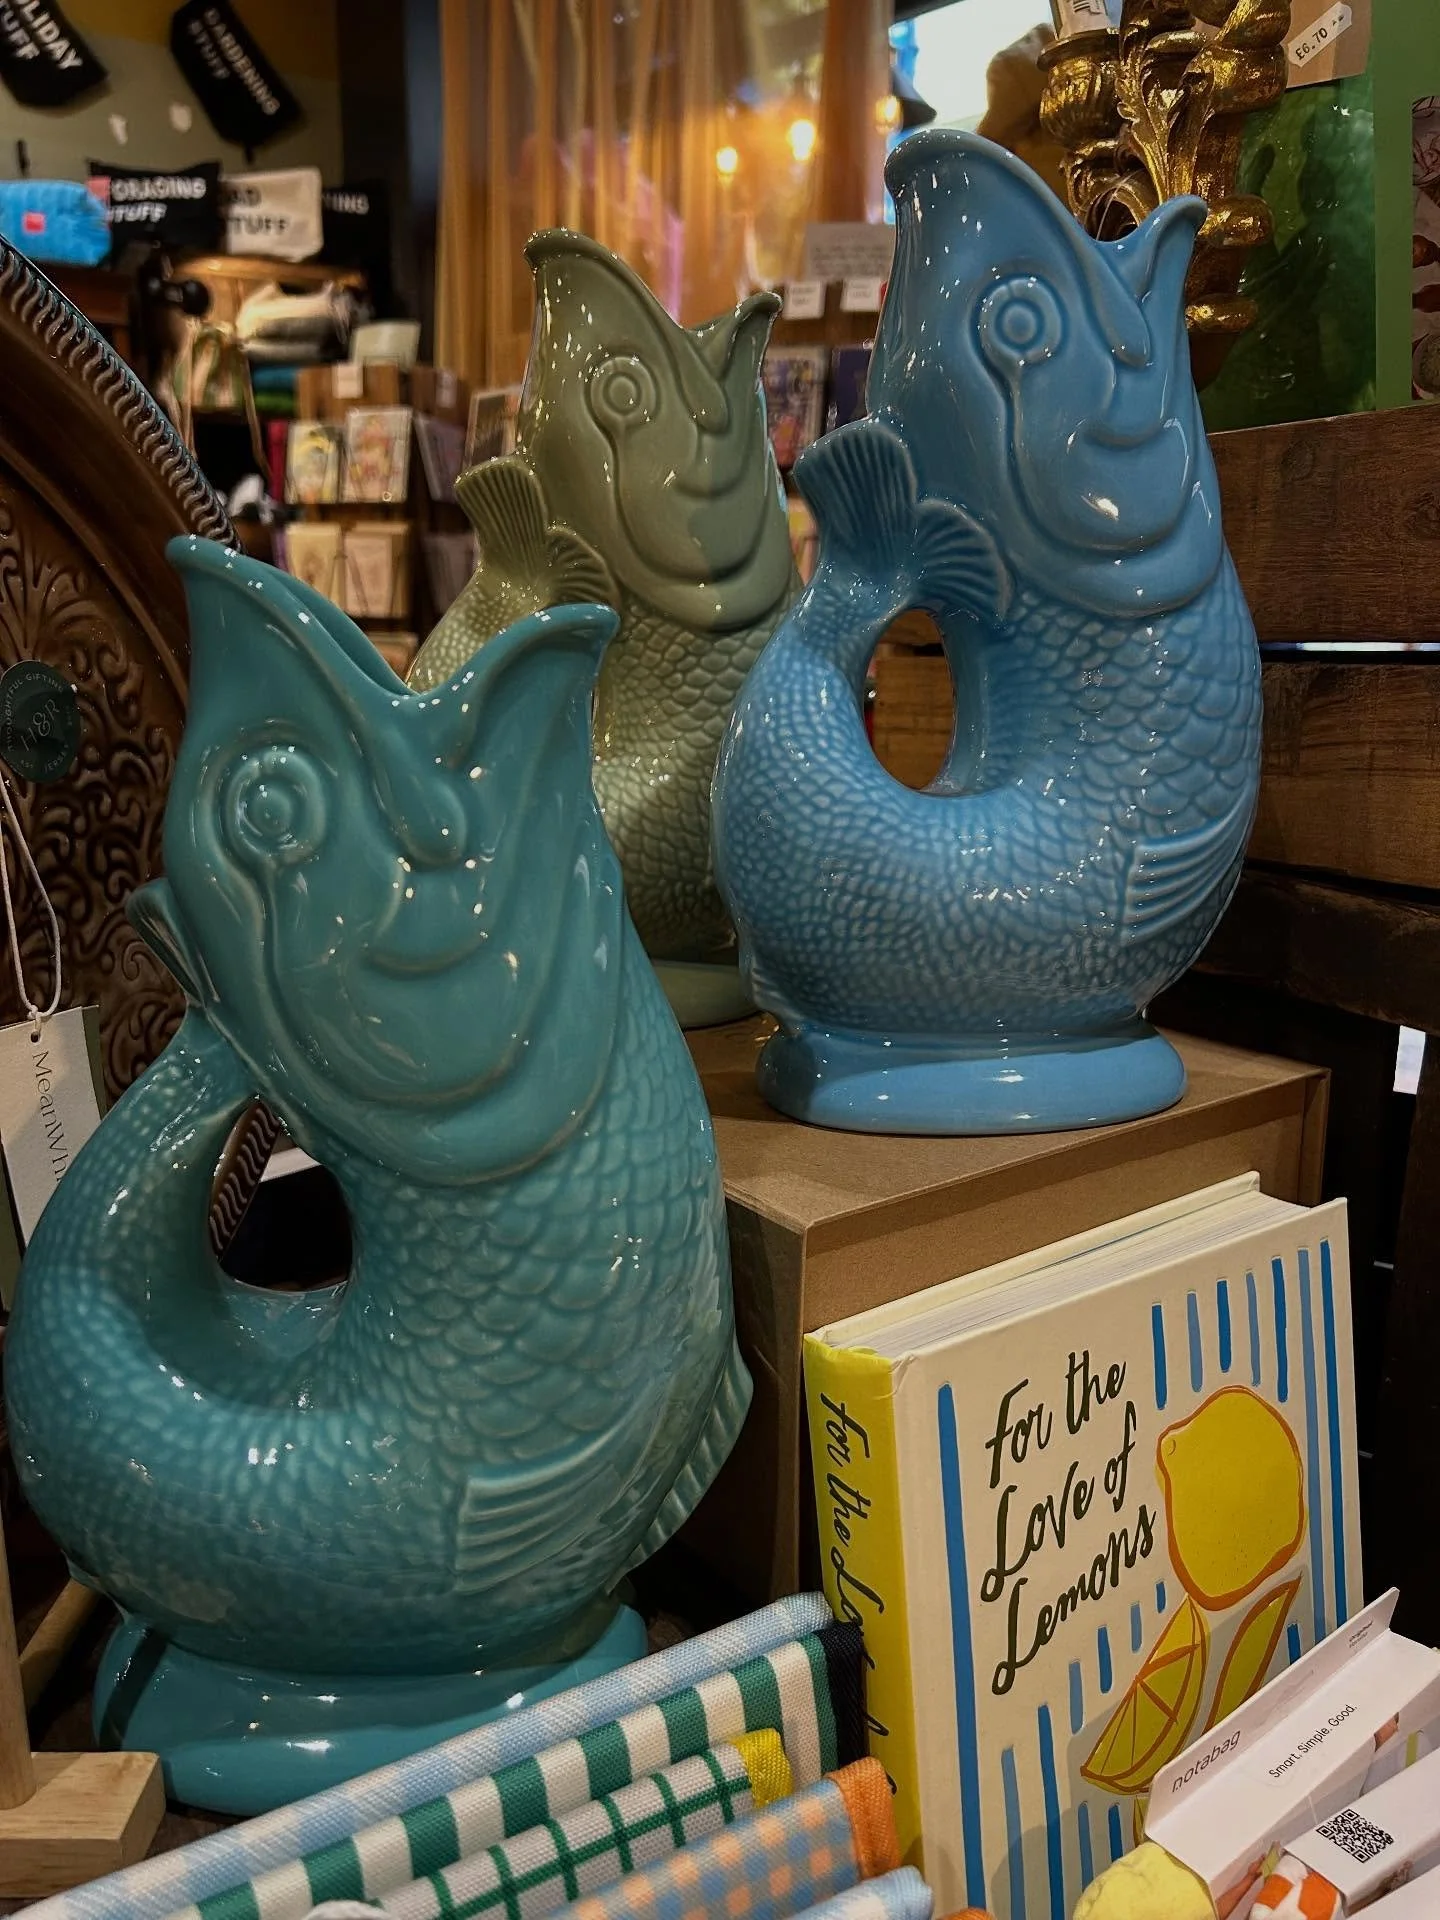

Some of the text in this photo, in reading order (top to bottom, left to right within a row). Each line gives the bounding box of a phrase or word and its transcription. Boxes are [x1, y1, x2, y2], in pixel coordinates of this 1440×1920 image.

[15, 0, 83, 69] LIDAY
[188, 20, 230, 79] STUFF
[204, 8, 280, 115] GARDENING
[1295, 27, 1328, 60] £6.70
[1065, 1350, 1127, 1435] the
[826, 1472, 872, 1548] the
[980, 1400, 1137, 1602] Love of
[991, 1504, 1157, 1696] Lemons
[1327, 1704, 1358, 1728] Good.
[1172, 1730, 1241, 1793] notabag
